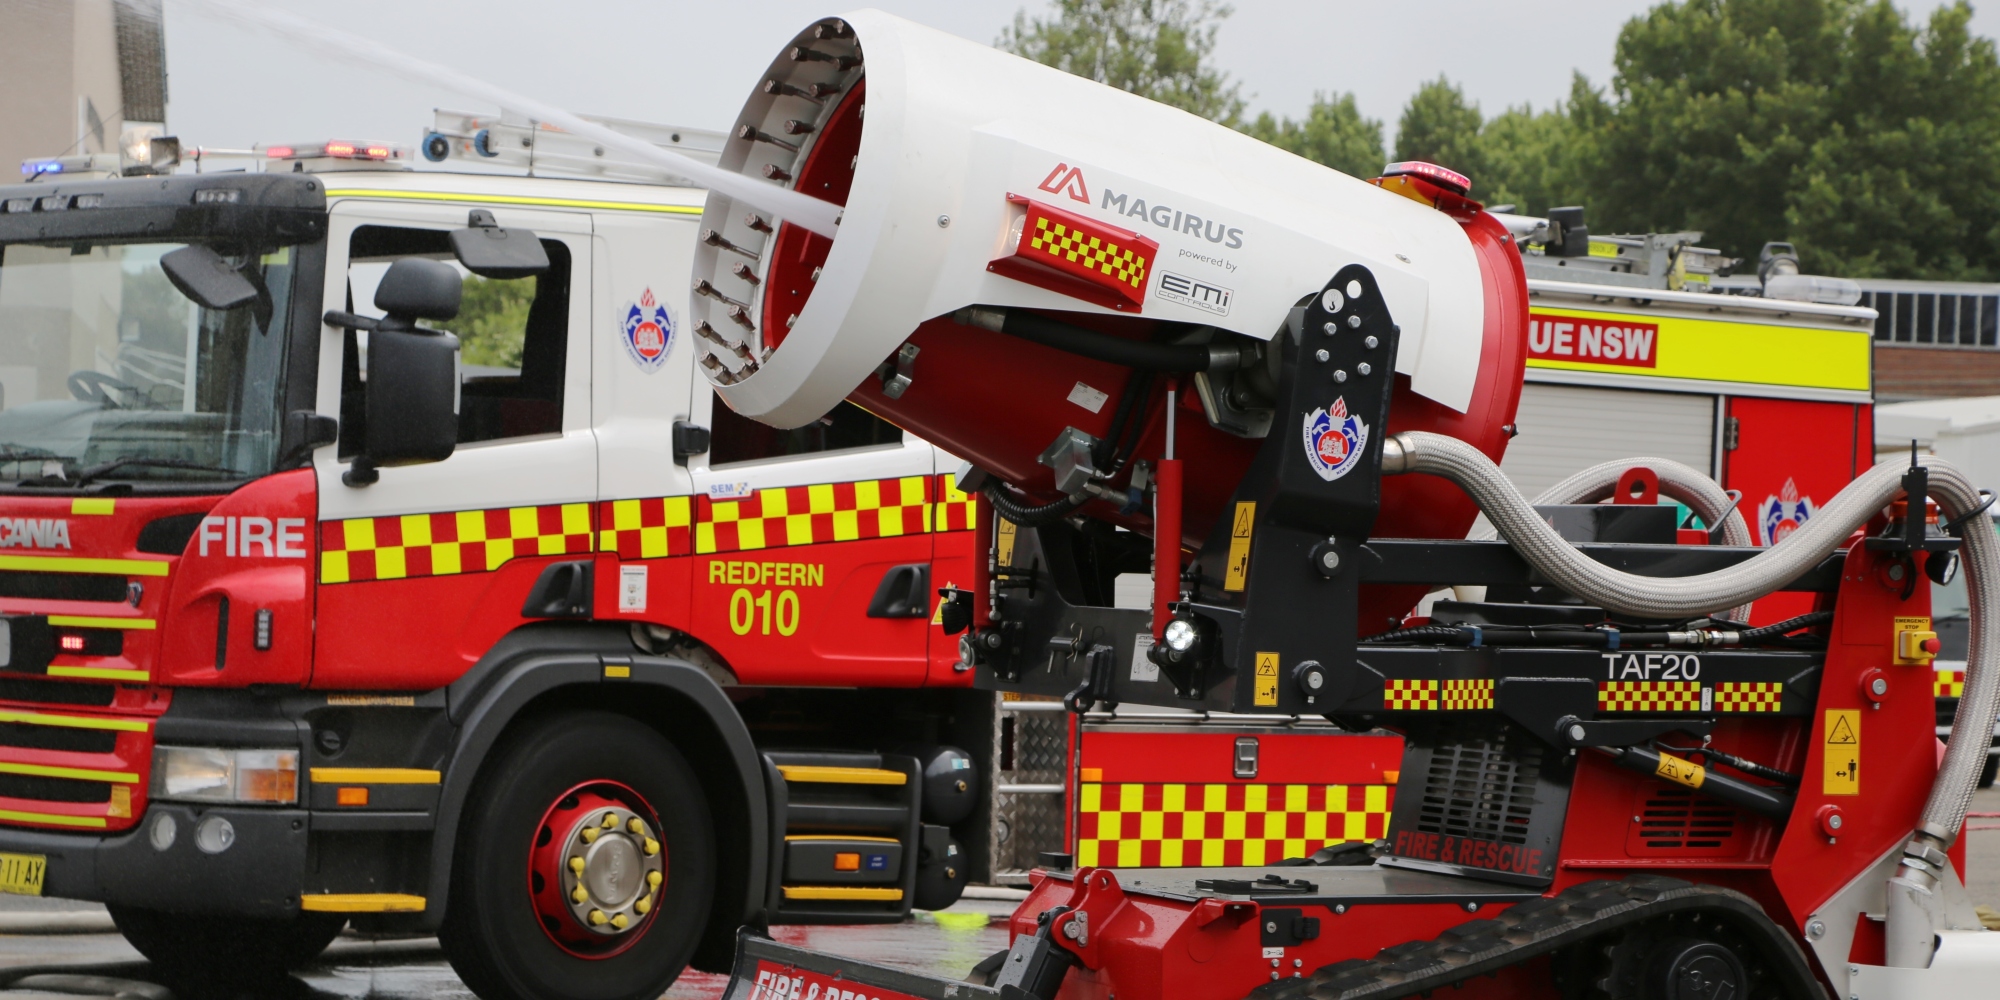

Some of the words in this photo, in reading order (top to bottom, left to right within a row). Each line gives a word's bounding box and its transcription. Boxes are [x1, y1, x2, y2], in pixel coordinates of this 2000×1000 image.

[1100, 188, 1244, 250] MAGIRUS
[1178, 248, 1224, 267] powered
[1225, 260, 1238, 274] by
[1529, 320, 1575, 355] UE
[1578, 324, 1655, 361] NSW
[711, 484, 734, 494] SEM
[200, 516, 307, 558] FIRE
[709, 560, 824, 587] REDFERN
[729, 588, 800, 637] 010
[1601, 654, 1700, 681] TAF20
[1394, 830, 1440, 860] FIRE
[1440, 836, 1455, 863] &
[1457, 839, 1543, 876] RESCUE
